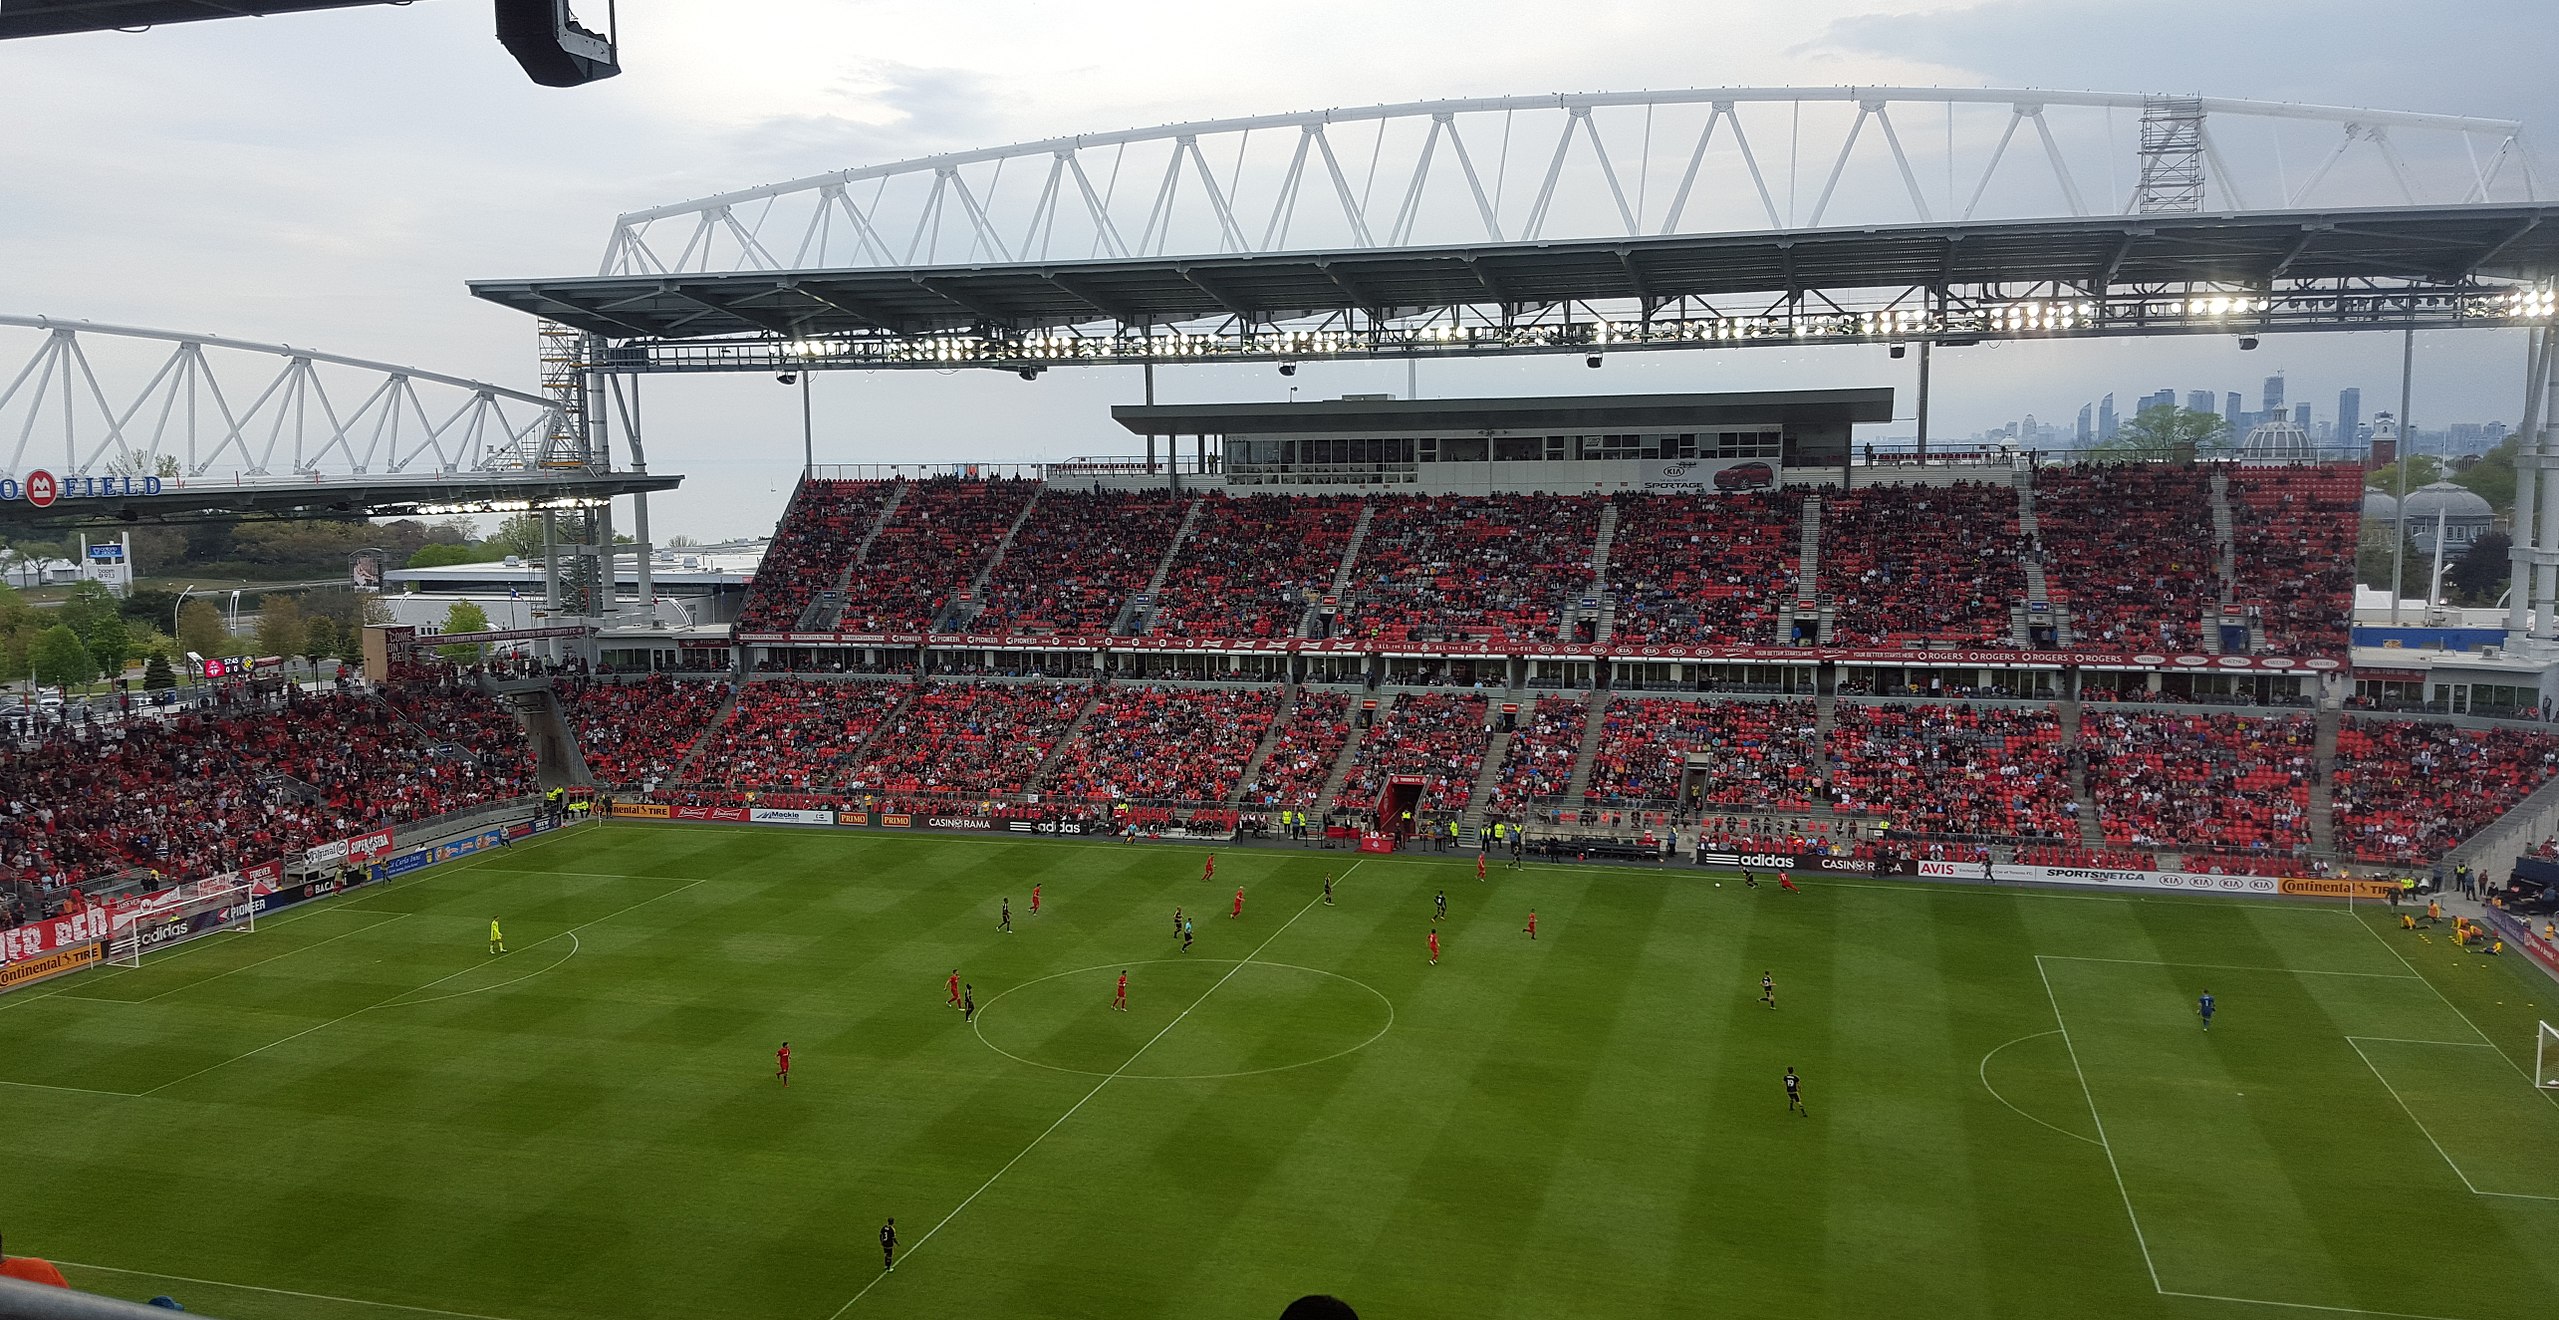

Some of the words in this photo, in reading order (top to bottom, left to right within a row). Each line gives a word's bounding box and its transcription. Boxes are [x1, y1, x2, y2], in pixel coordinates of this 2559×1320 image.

[63, 476, 162, 498] FIELD
[390, 632, 411, 642] COME
[443, 635, 471, 643] BENJAMIN
[472, 634, 491, 642] MOORE
[1928, 652, 1963, 660] ROGERS
[841, 814, 866, 823] PRIMO
[884, 816, 909, 825] PRIMO
[964, 819, 990, 829] RAMA
[1741, 854, 1794, 868] adidas
[1920, 863, 1954, 875] AVIS
[2047, 869, 2145, 882] SPORTSNET.CA
[2163, 876, 2179, 884] KIA
[2192, 878, 2209, 886] KIA
[2253, 881, 2270, 889] KIA
[2282, 879, 2353, 894] Continental
[230, 899, 266, 917] PIONEER
[73, 947, 98, 962] TIRE
[1787, 1079, 1794, 1087] 19
